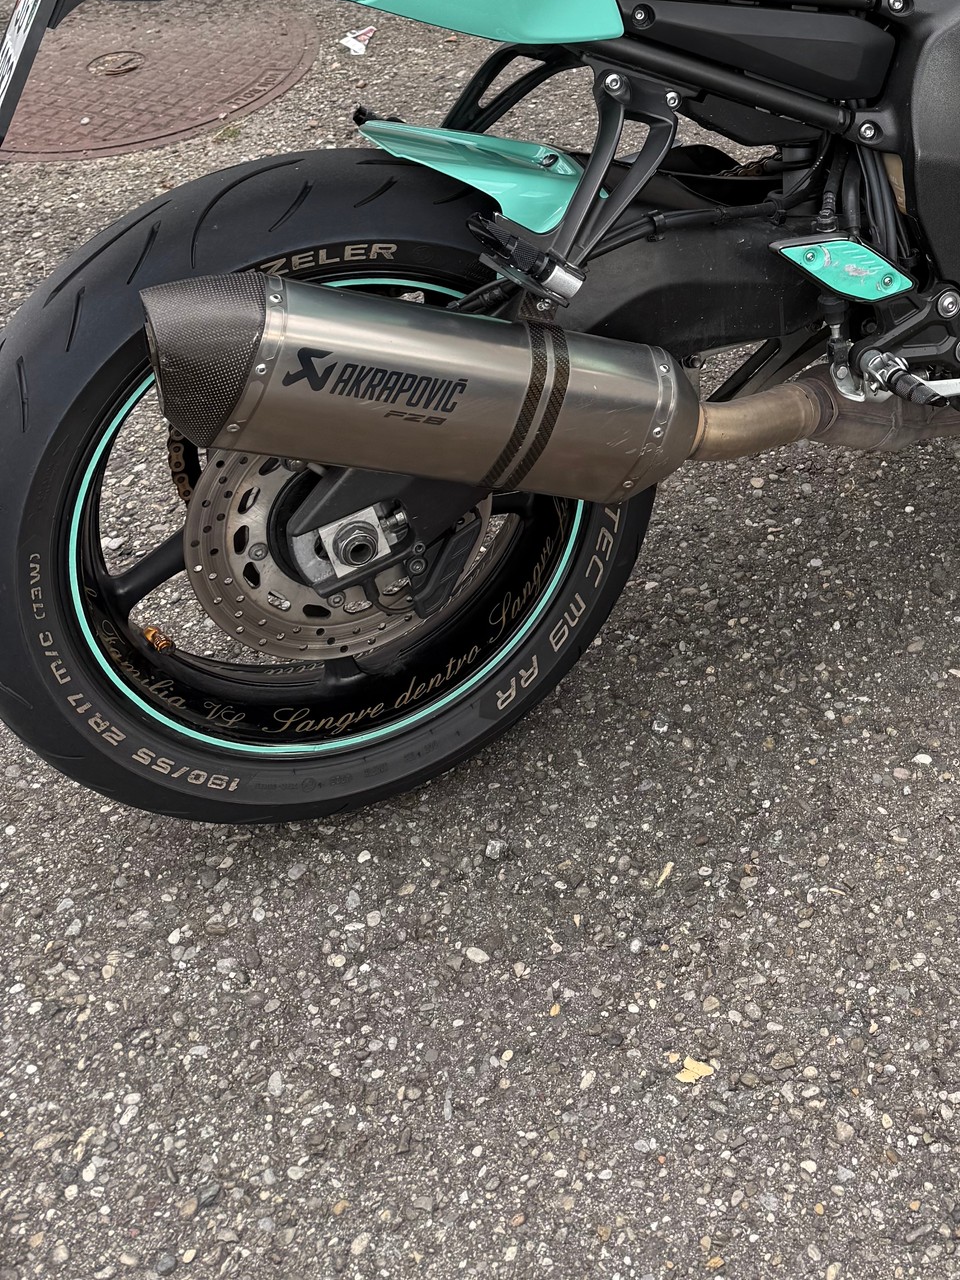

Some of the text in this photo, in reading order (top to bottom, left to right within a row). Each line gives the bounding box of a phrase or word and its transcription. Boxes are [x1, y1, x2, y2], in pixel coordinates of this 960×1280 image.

[250, 243, 398, 277] ZELER
[101, 620, 187, 710] Familia
[262, 701, 385, 735] Sangre
[394, 644, 482, 710] dentro
[489, 535, 552, 644] Sangre
[495, 505, 621, 711] TEC M9 RR
[38, 631, 72, 685] M/C
[131, 746, 241, 791] 190/55
